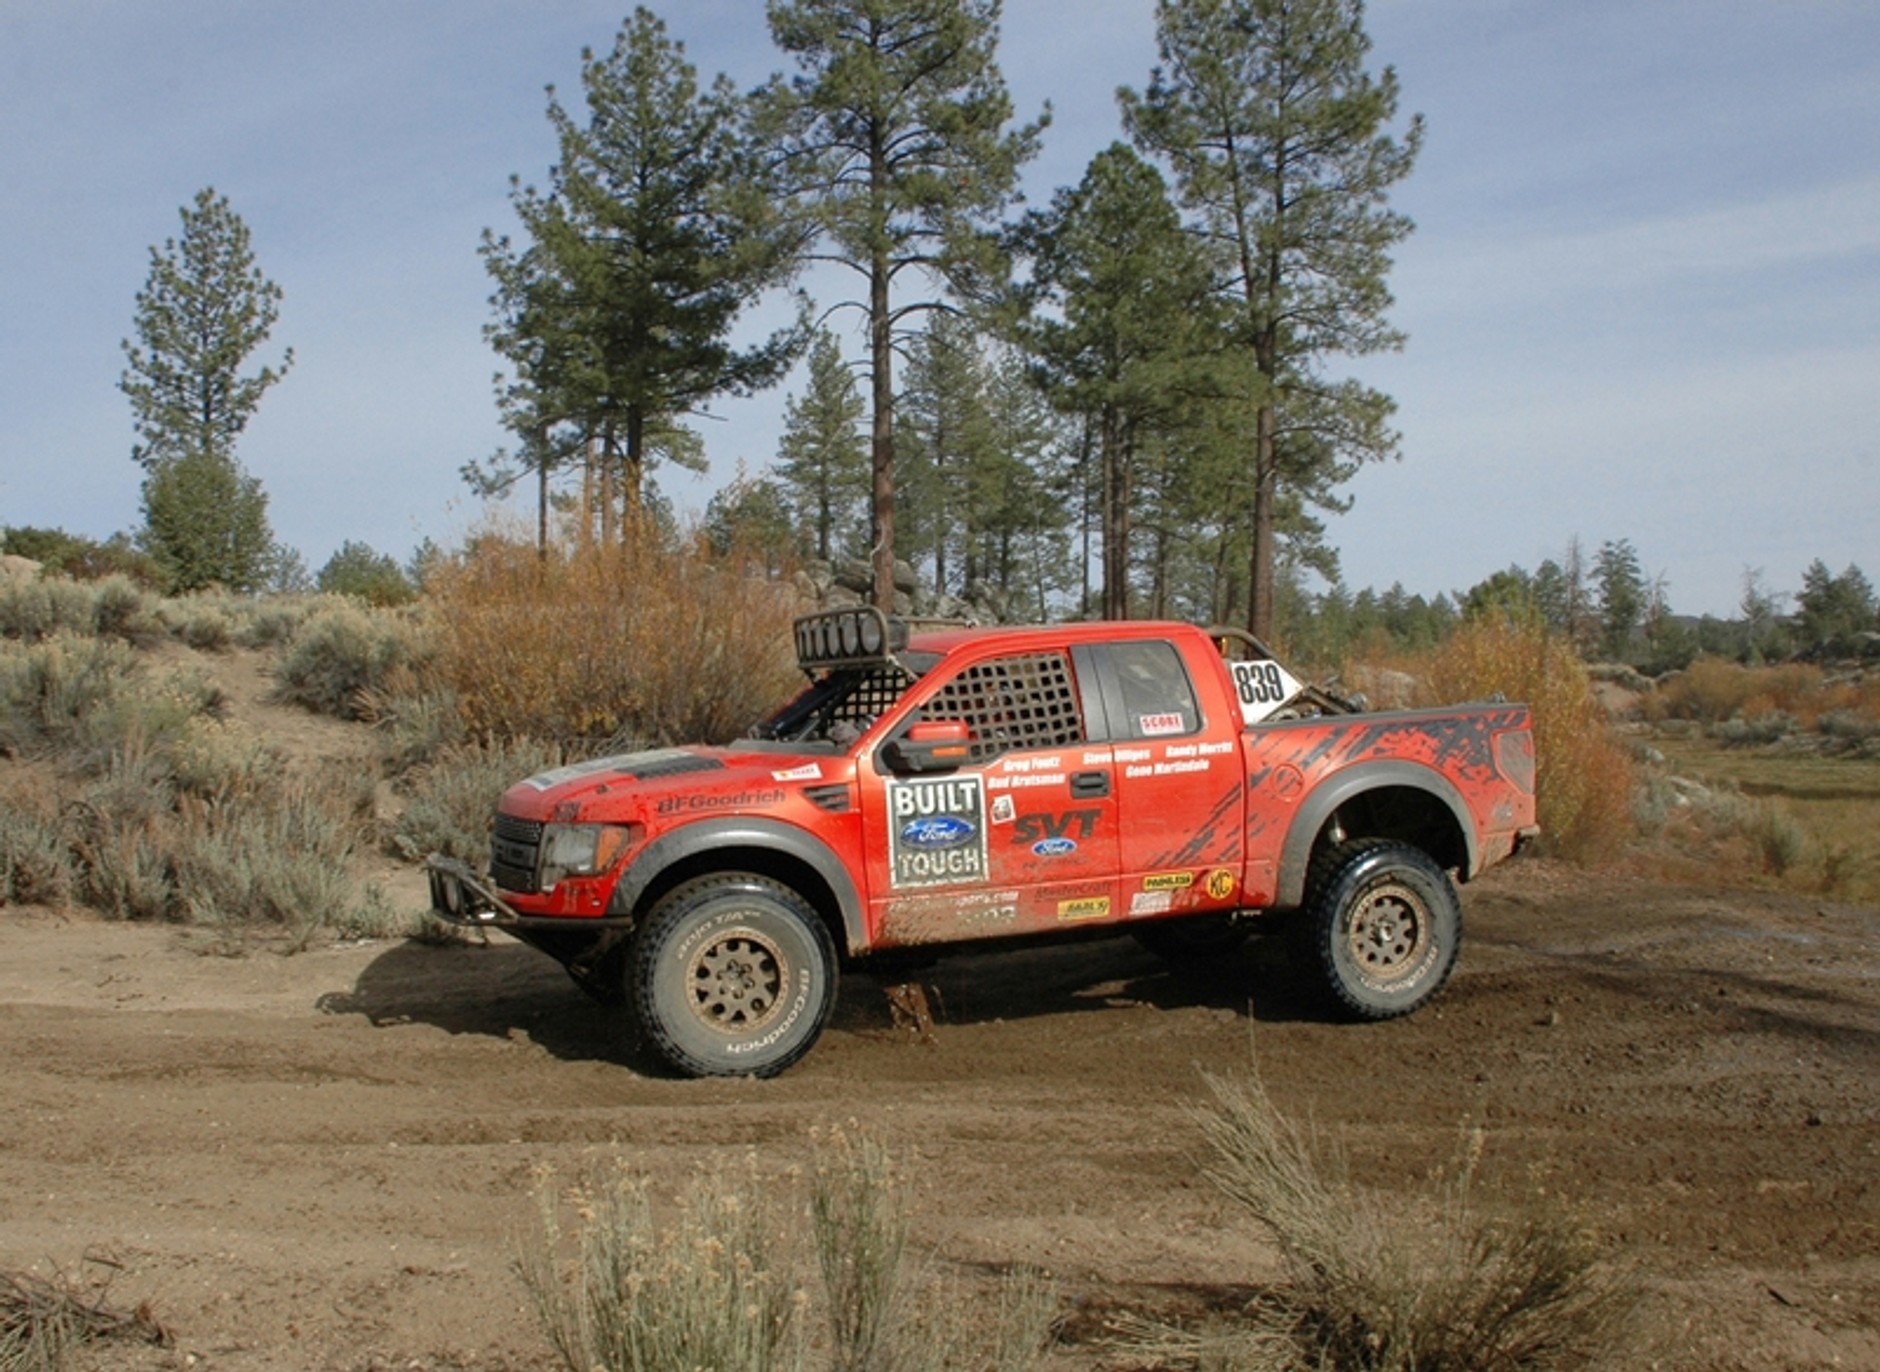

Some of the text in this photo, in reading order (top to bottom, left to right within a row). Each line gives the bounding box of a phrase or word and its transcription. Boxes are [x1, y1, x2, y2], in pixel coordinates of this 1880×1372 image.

[1234, 663, 1284, 704] 839
[657, 788, 787, 814] BFGoodrich
[895, 782, 977, 816] BUILT
[1011, 807, 1103, 844] SVT
[897, 848, 979, 877] TOUGH
